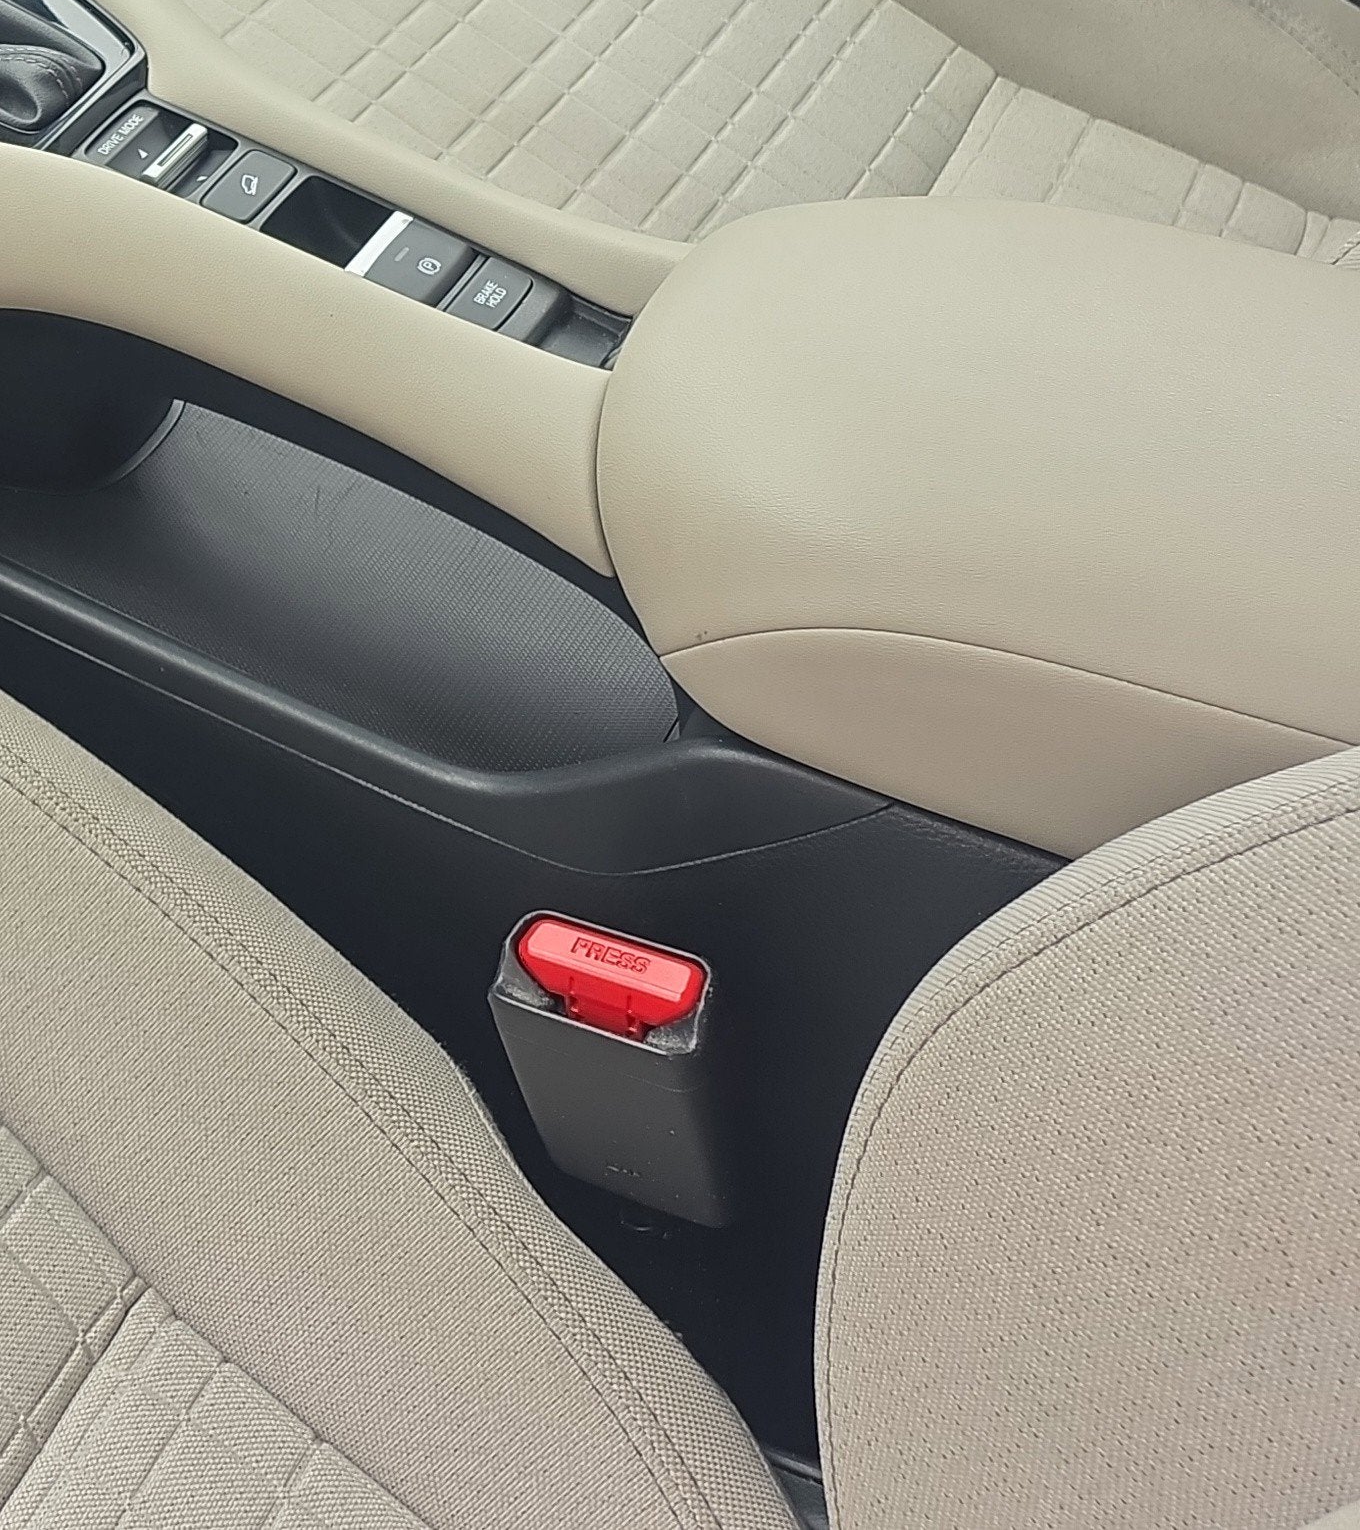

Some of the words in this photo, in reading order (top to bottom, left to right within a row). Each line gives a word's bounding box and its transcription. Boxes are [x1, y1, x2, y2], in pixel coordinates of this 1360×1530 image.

[97, 131, 124, 155] DRIVE
[120, 113, 145, 138] MODE
[473, 279, 499, 306] BRAKE
[485, 286, 507, 309] HOLD
[570, 936, 652, 975] PRESS
